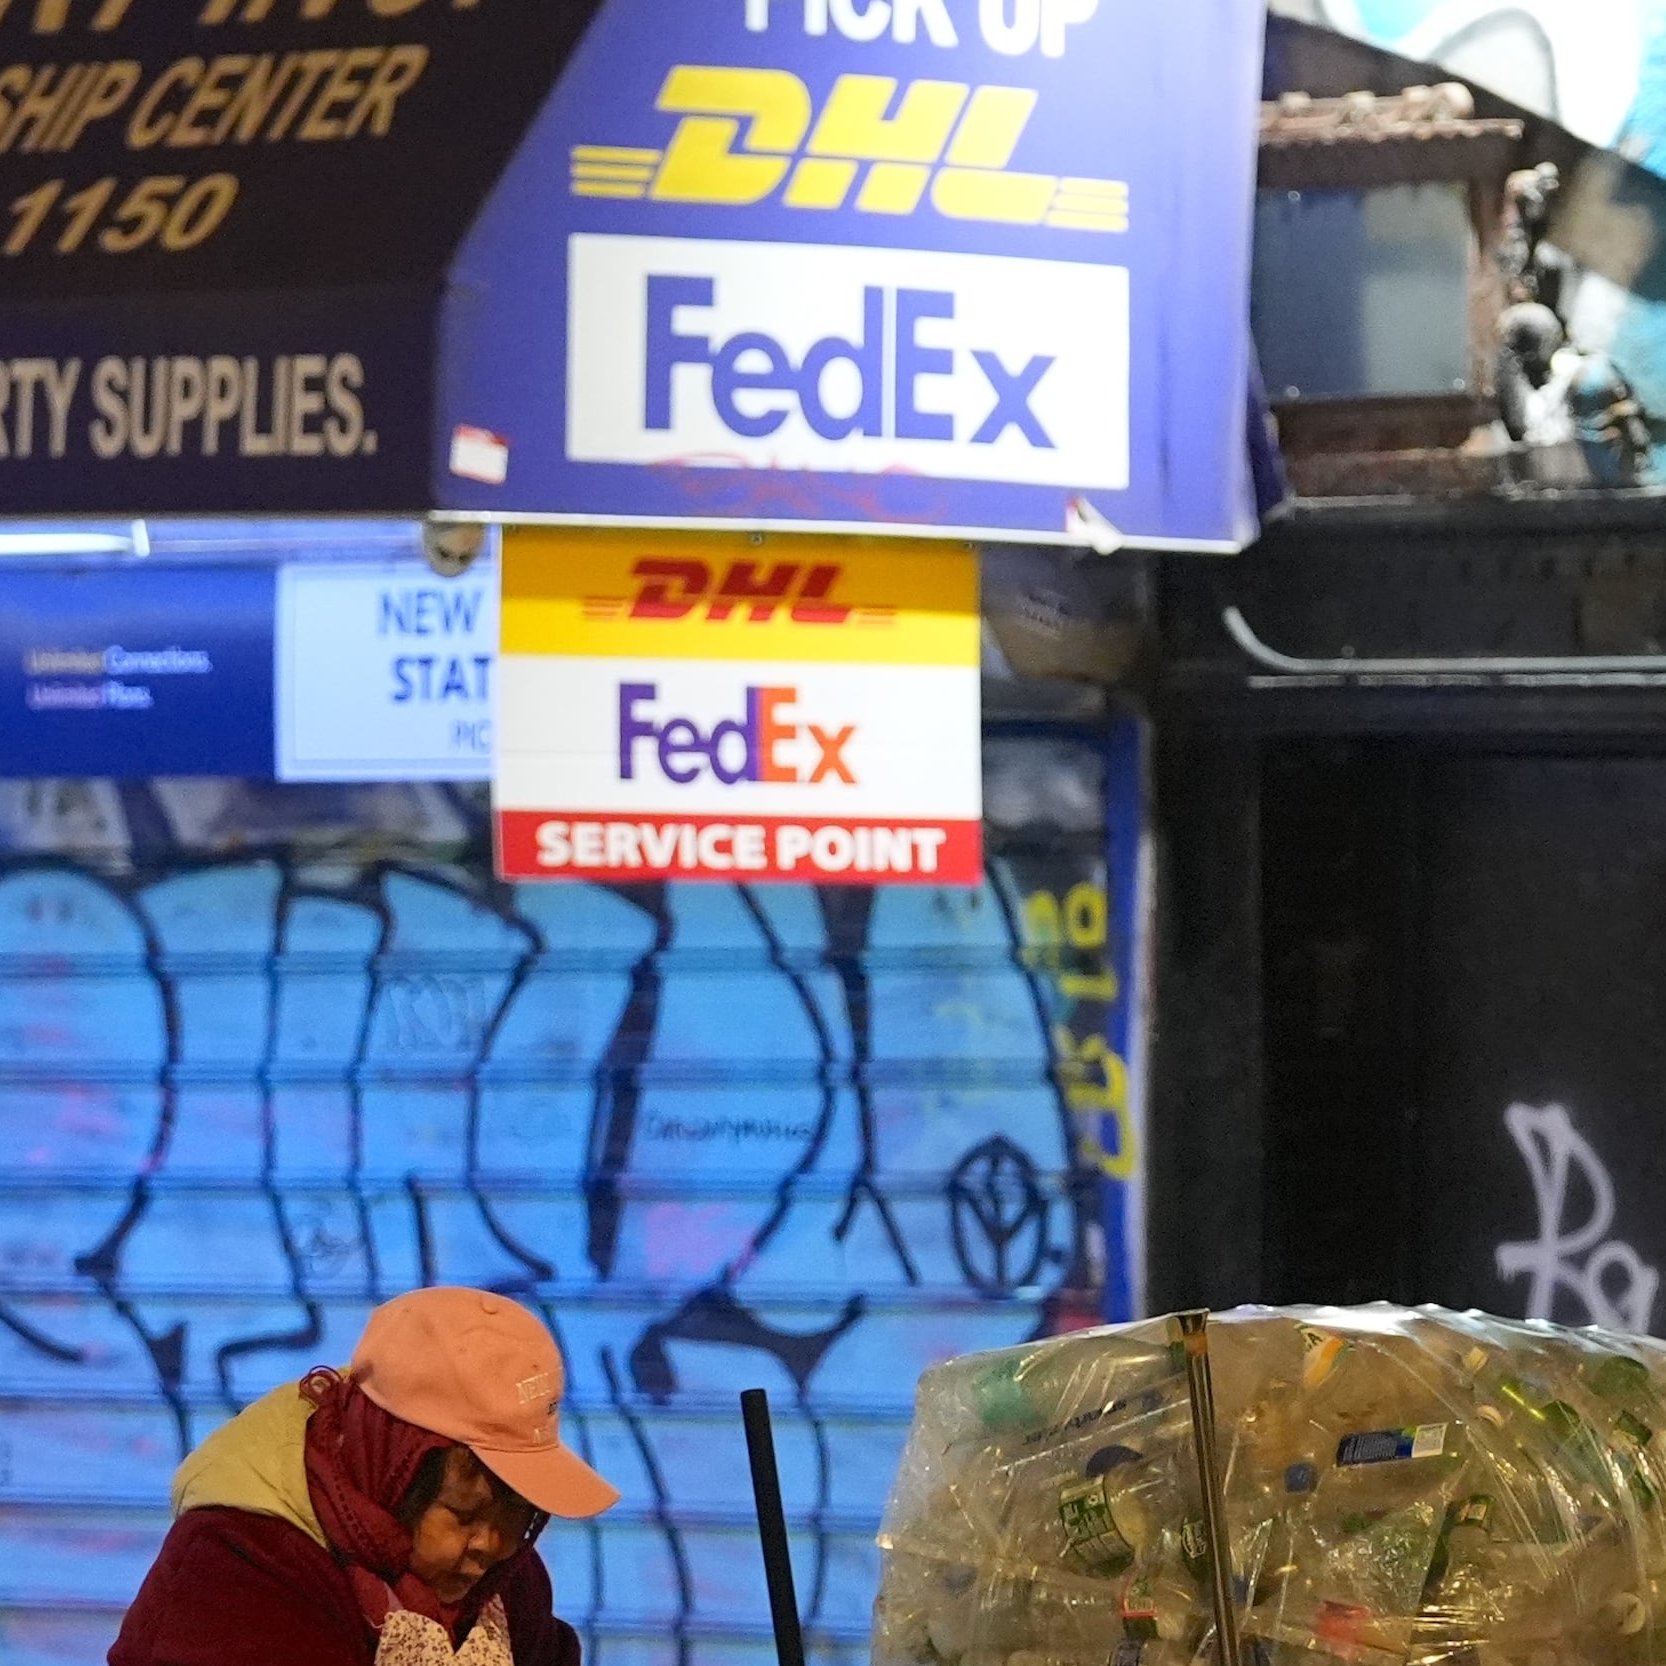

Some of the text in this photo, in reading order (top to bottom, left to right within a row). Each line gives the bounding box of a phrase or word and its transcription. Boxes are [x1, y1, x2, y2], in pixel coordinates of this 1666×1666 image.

[977, 0, 1101, 58] UP
[123, 44, 430, 149] CENTER
[648, 64, 1057, 226] DHL
[90, 353, 379, 458] SUPPLIES.
[642, 274, 1059, 451] FedEx
[378, 591, 481, 638] NEW
[629, 556, 854, 623] DHL
[618, 680, 857, 785] FedEx
[537, 822, 946, 873] SERVICE POINT
